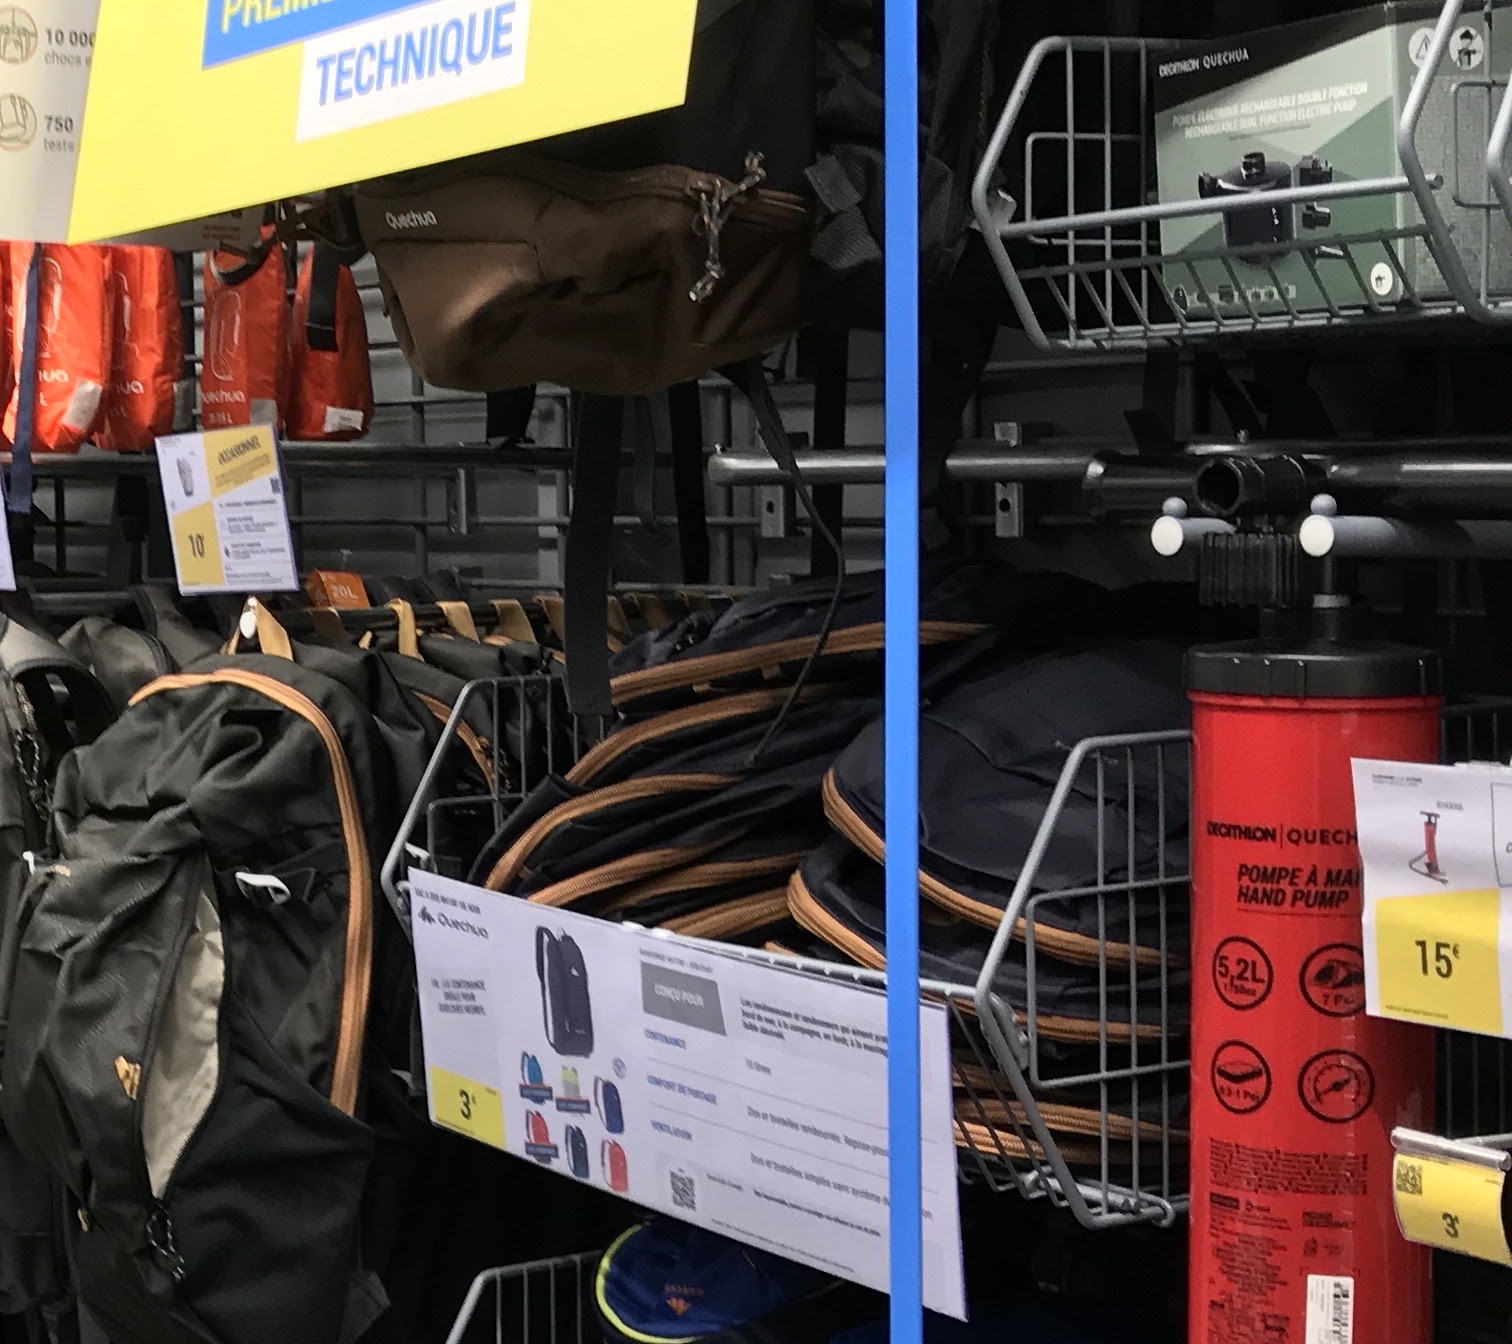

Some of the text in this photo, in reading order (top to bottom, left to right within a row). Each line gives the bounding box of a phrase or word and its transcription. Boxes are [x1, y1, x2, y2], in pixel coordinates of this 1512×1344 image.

[45, 28, 65, 47] 10
[316, 0, 517, 108] TECHNIQUE
[1202, 47, 1250, 70] QUECHUA
[44, 115, 74, 133] 750
[43, 137, 75, 153] tests
[1237, 862, 1305, 887] POMPE
[1305, 863, 1319, 888] À
[1236, 885, 1350, 909] HAND PUMP
[436, 911, 489, 940] Quechua
